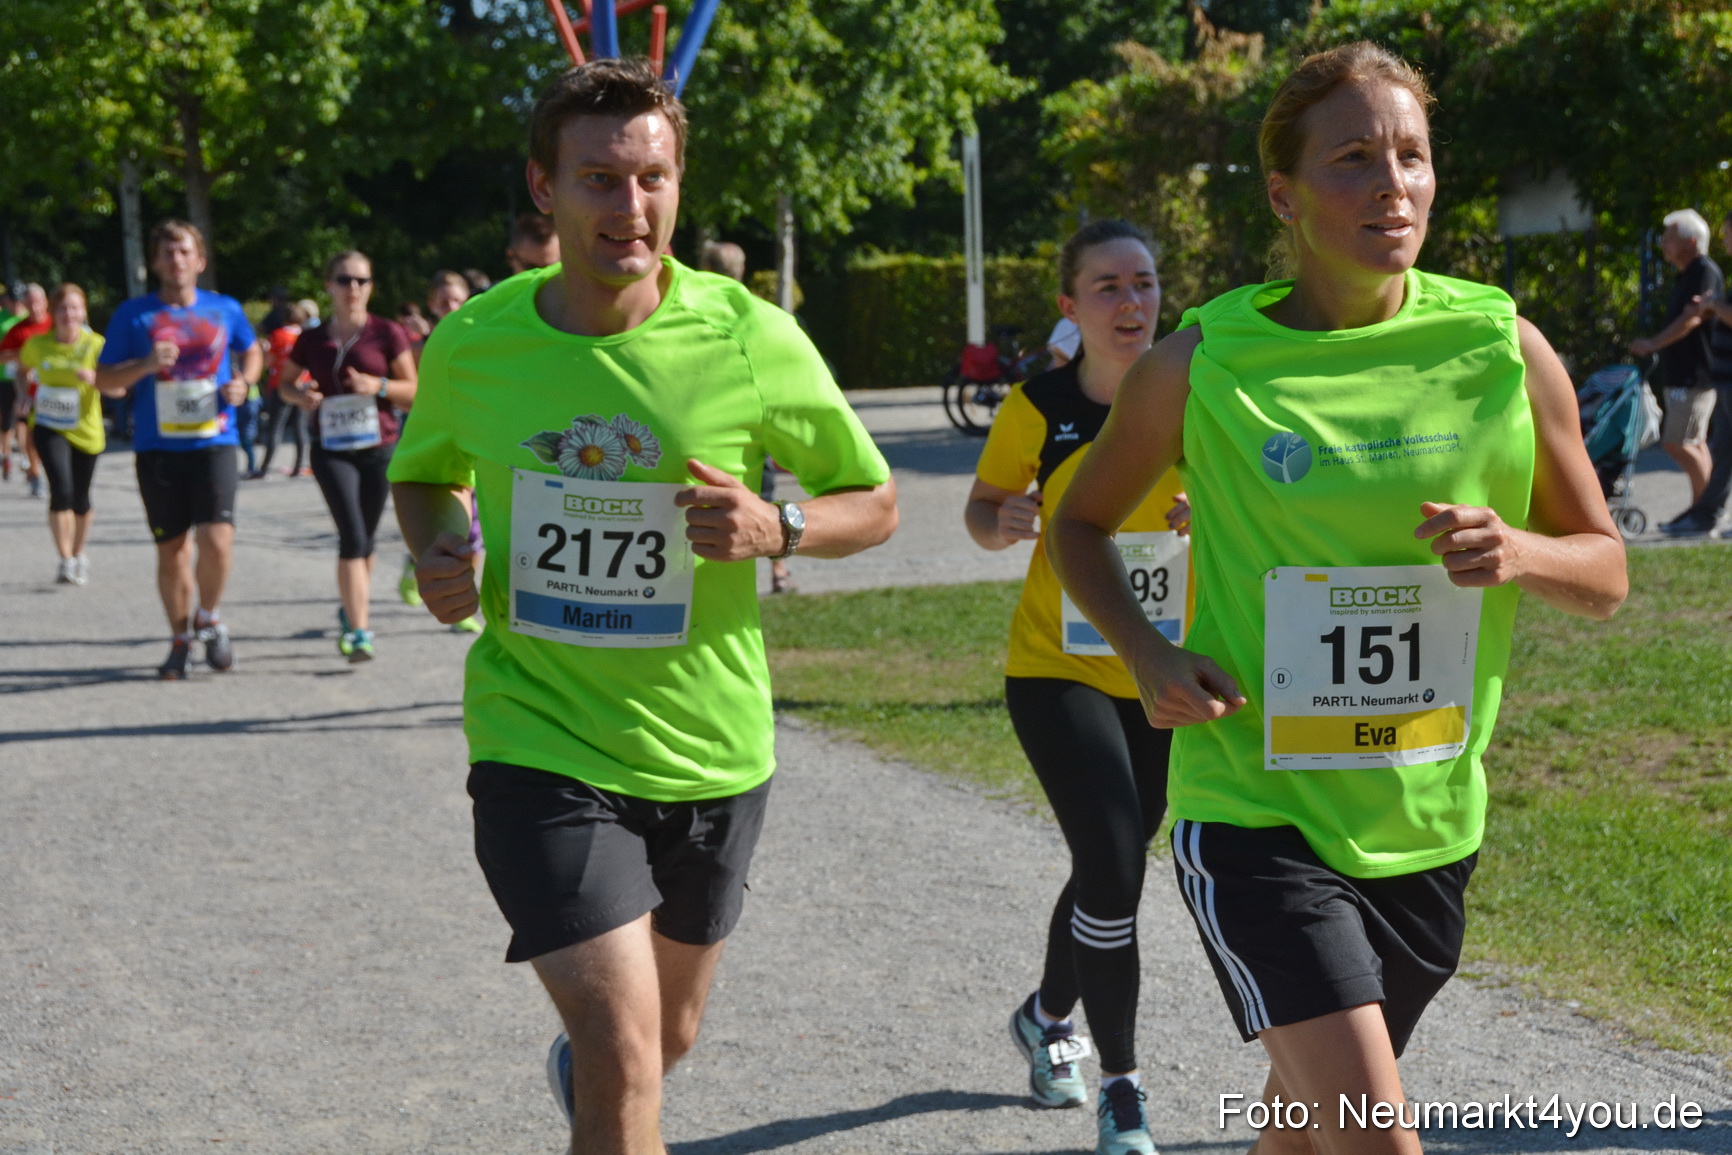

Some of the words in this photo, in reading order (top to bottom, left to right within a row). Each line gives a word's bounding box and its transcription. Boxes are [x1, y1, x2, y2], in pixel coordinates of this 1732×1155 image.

[1318, 445, 1343, 455] Freie
[1345, 438, 1401, 452] katholische
[1402, 432, 1459, 445] Volksschule
[1319, 457, 1331, 467] im
[1333, 456, 1354, 466] Haus
[1356, 455, 1366, 463] St.
[564, 494, 643, 515] BOCK
[521, 557, 527, 566] C
[537, 523, 666, 580] 2173
[546, 580, 582, 594] PARTL
[585, 586, 638, 597] Neumarkt
[1130, 567, 1169, 603] 93
[1330, 585, 1422, 607] BOCK
[563, 604, 632, 629] Martin
[1330, 608, 1359, 616] inspired
[1360, 608, 1369, 616] by
[1393, 606, 1422, 614] concepts
[1320, 622, 1420, 685] 151
[1277, 674, 1285, 684] D
[1313, 696, 1357, 707] PARTL
[1361, 693, 1419, 706] Neumarkt
[1355, 723, 1397, 746] Eva
